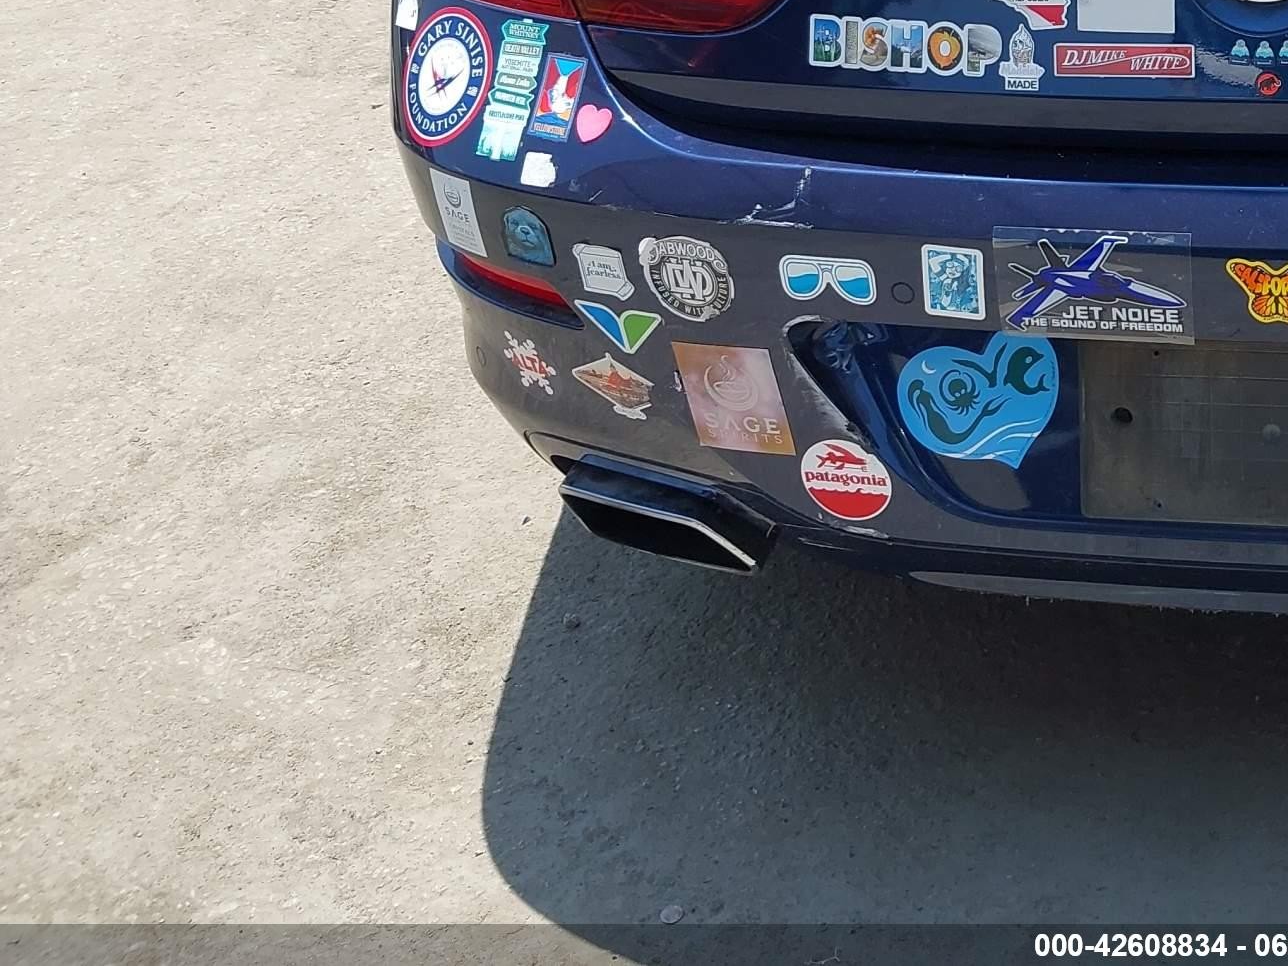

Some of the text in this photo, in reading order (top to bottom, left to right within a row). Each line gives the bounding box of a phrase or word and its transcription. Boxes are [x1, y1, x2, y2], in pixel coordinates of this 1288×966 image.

[510, 23, 541, 33] MOUNT
[418, 19, 483, 78] GARY SINISE
[811, 16, 1001, 74] BISHOP
[1130, 55, 1184, 71] WHITE
[1007, 79, 1038, 90] MADE
[409, 83, 468, 132] FOUNDATION
[445, 206, 470, 223] SAGE
[651, 269, 681, 309] INFUSED
[713, 275, 727, 309] ULTURE
[1062, 305, 1179, 324] JET NOISE
[1022, 316, 1184, 333] THE SOUND OF FREEDOM
[511, 352, 549, 378] ALTA
[703, 411, 781, 435] SAGE
[707, 428, 784, 445] SPIRITS
[804, 471, 888, 487] patagonia
